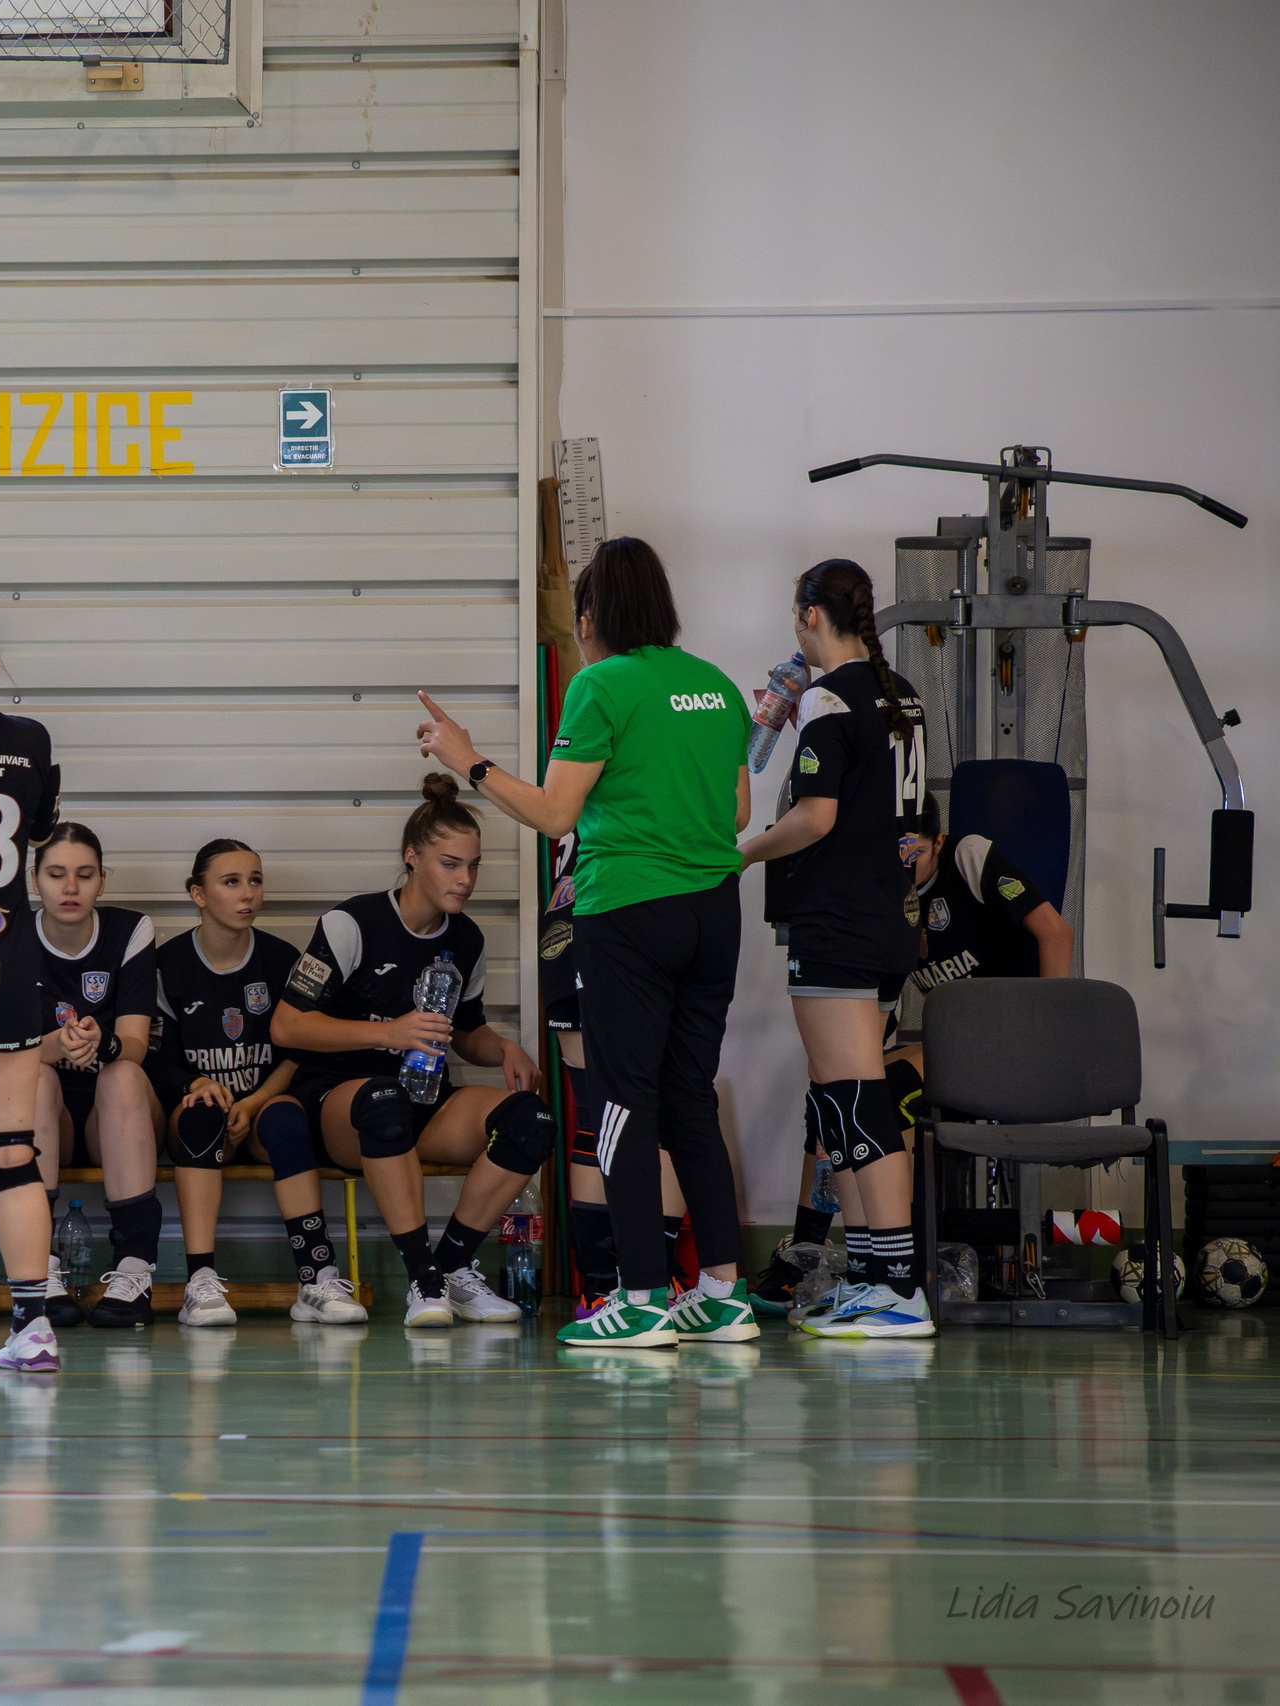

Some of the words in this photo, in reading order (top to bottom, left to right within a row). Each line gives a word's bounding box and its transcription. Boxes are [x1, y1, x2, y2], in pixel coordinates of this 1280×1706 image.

[669, 692, 726, 712] COACH
[86, 976, 106, 984] CSO
[247, 987, 266, 996] CSO
[548, 1019, 572, 1029] Kempa
